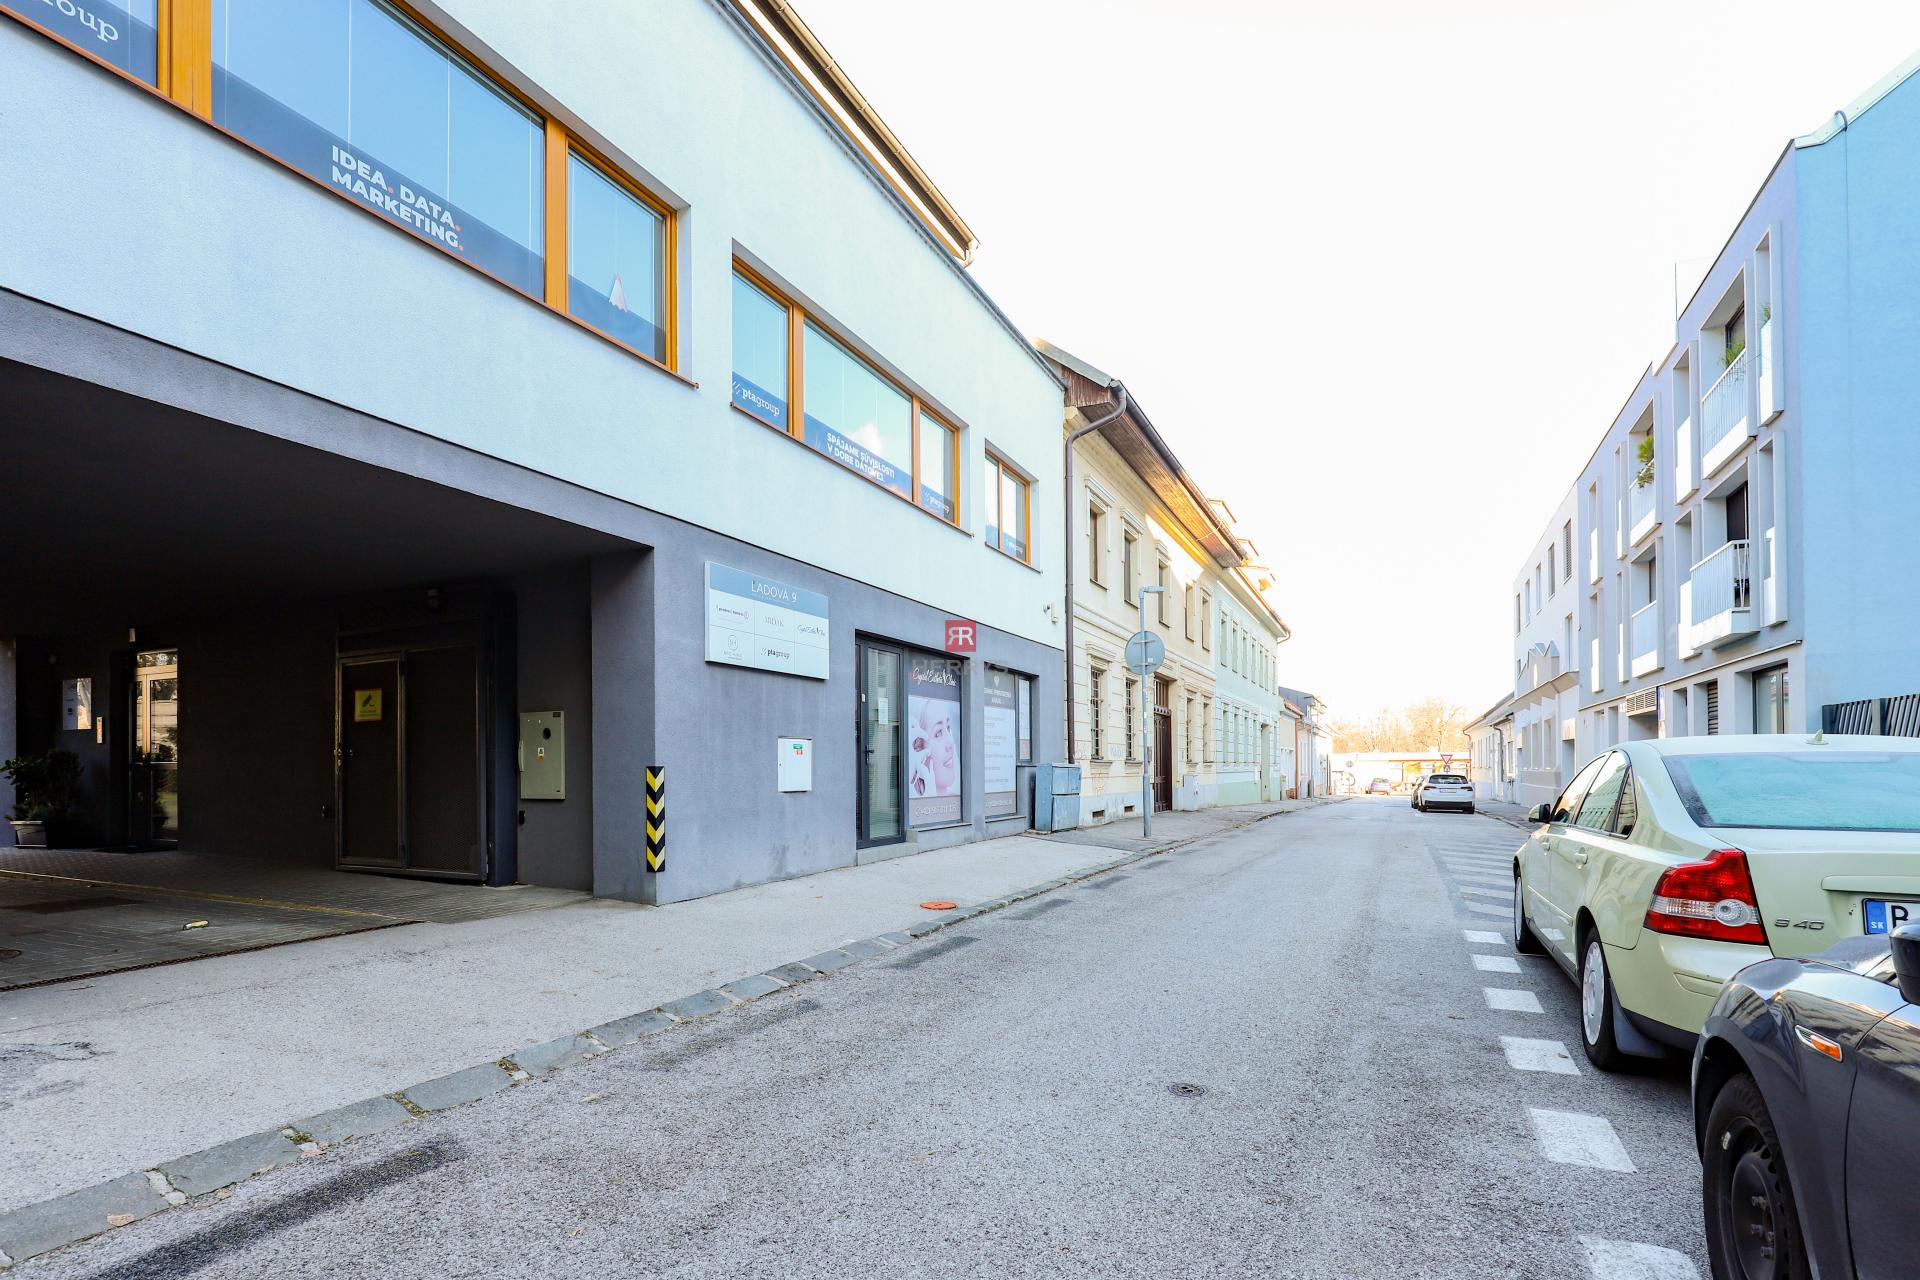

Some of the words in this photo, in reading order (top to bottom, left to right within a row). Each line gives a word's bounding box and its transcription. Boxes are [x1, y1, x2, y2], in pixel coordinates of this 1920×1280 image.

[332, 145, 394, 194] IDEA.
[400, 183, 462, 232] DATA.
[332, 165, 465, 252] MARKETING.
[742, 387, 780, 417] ptagroup
[834, 448, 854, 465] DOBE
[791, 591, 798, 602] 9
[1870, 921, 1884, 930] SK
